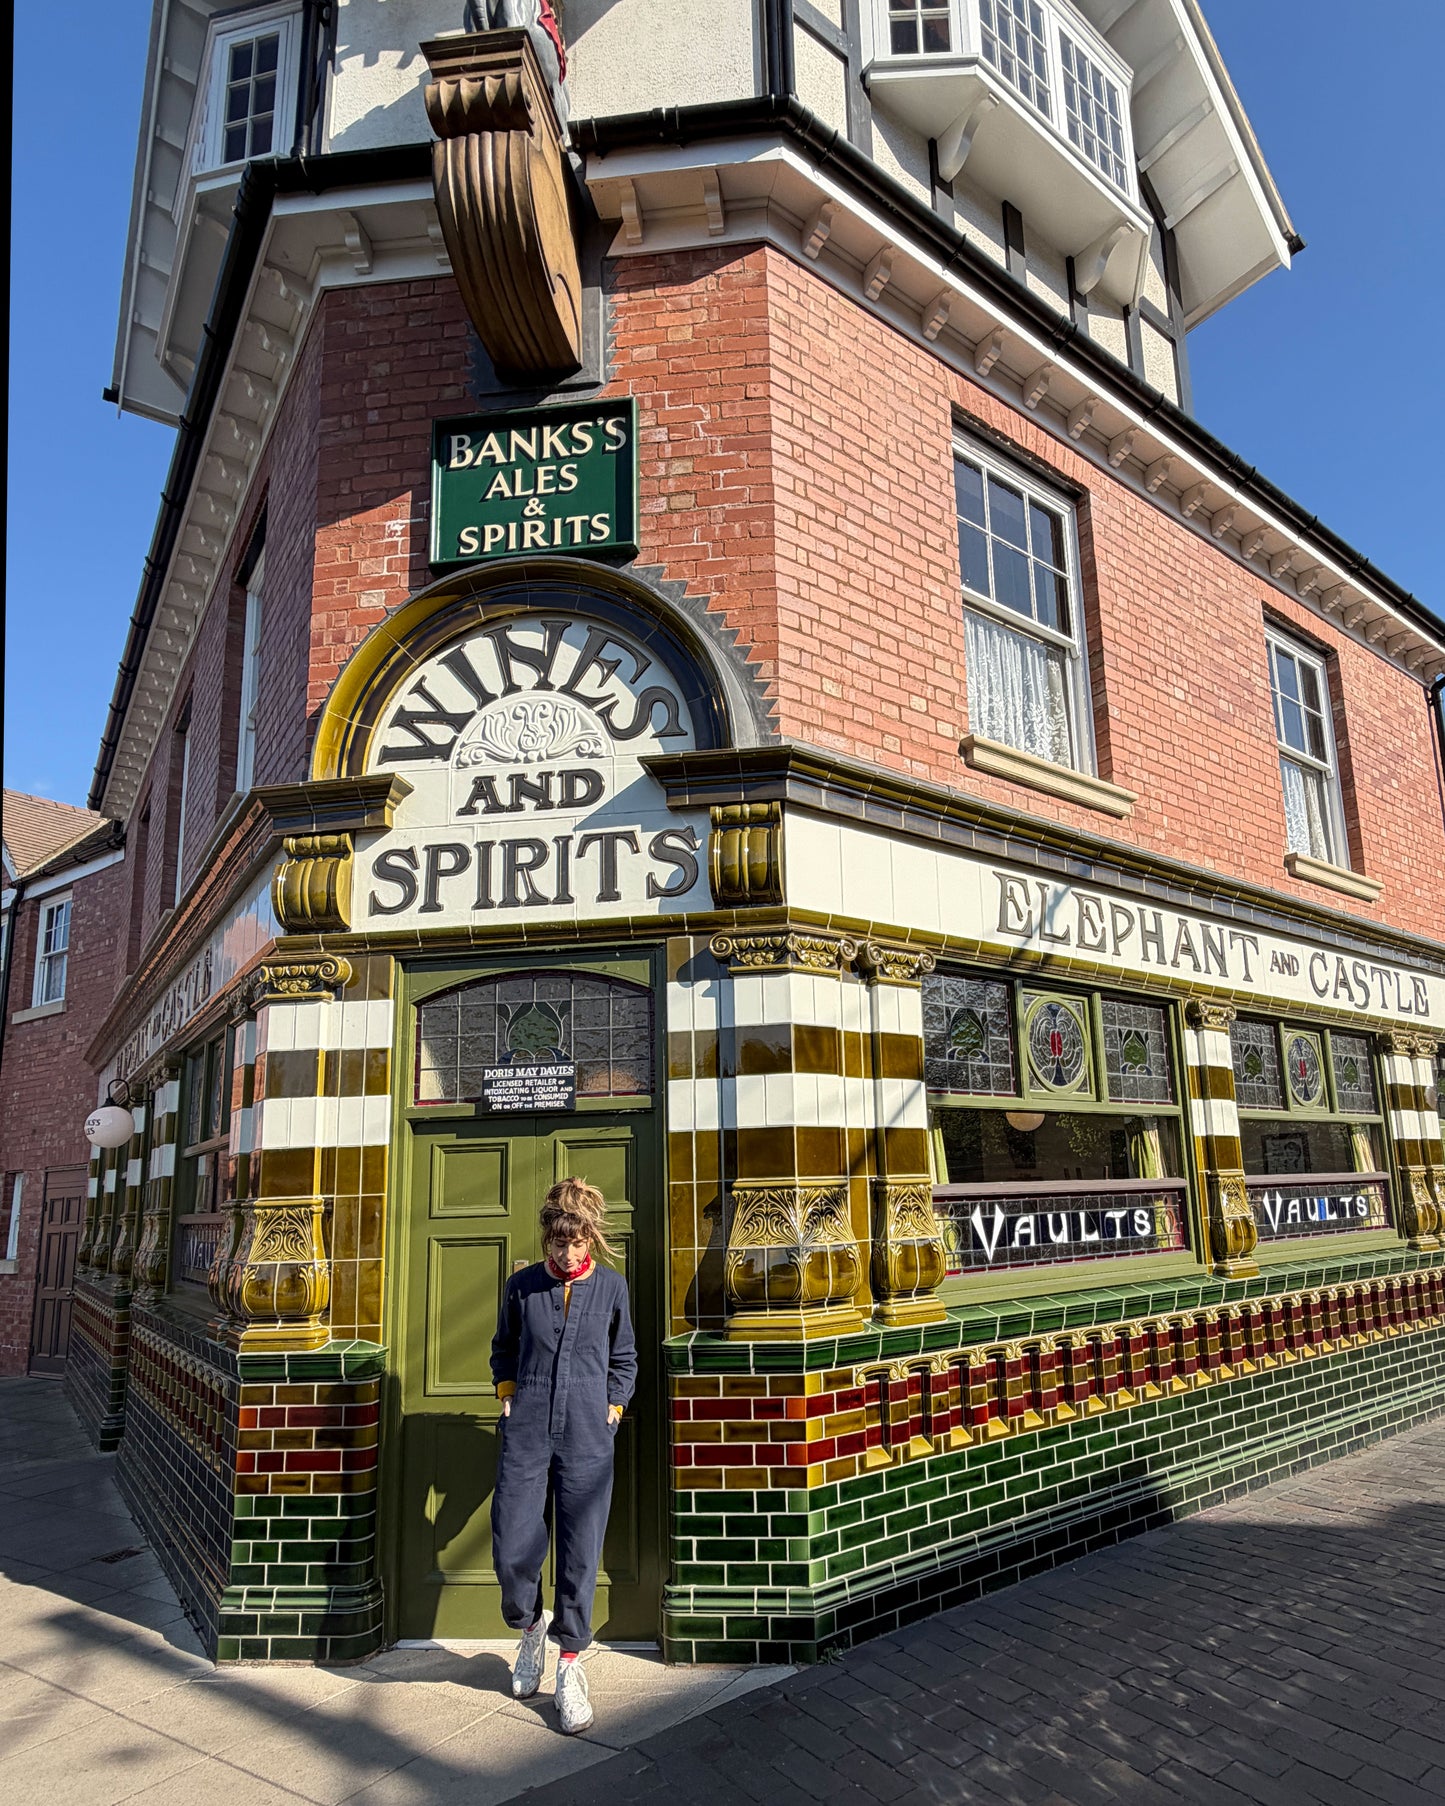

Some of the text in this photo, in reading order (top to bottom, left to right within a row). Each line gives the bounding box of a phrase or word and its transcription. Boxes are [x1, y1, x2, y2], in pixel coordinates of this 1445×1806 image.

[450, 417, 627, 469] BANKS'S
[485, 463, 579, 500] ALES
[523, 497, 547, 517] &
[458, 513, 611, 555] SPIRITS
[377, 620, 688, 765] WINES
[455, 768, 606, 816] AND
[368, 825, 699, 917] SPIRITS
[992, 870, 1430, 1017] ELEPHANT AND CASTLE
[484, 1066, 574, 1078] DORIS MAY DAVIES
[484, 1087, 530, 1095] INTOXICATING
[531, 1086, 558, 1094] LIQUOR
[493, 1080, 523, 1088] LICENSED
[525, 1078, 557, 1086] RETAILER
[488, 1095, 519, 1103] TOBACCO
[533, 1092, 569, 1101] CONSUMED
[511, 1101, 523, 1109] OFF
